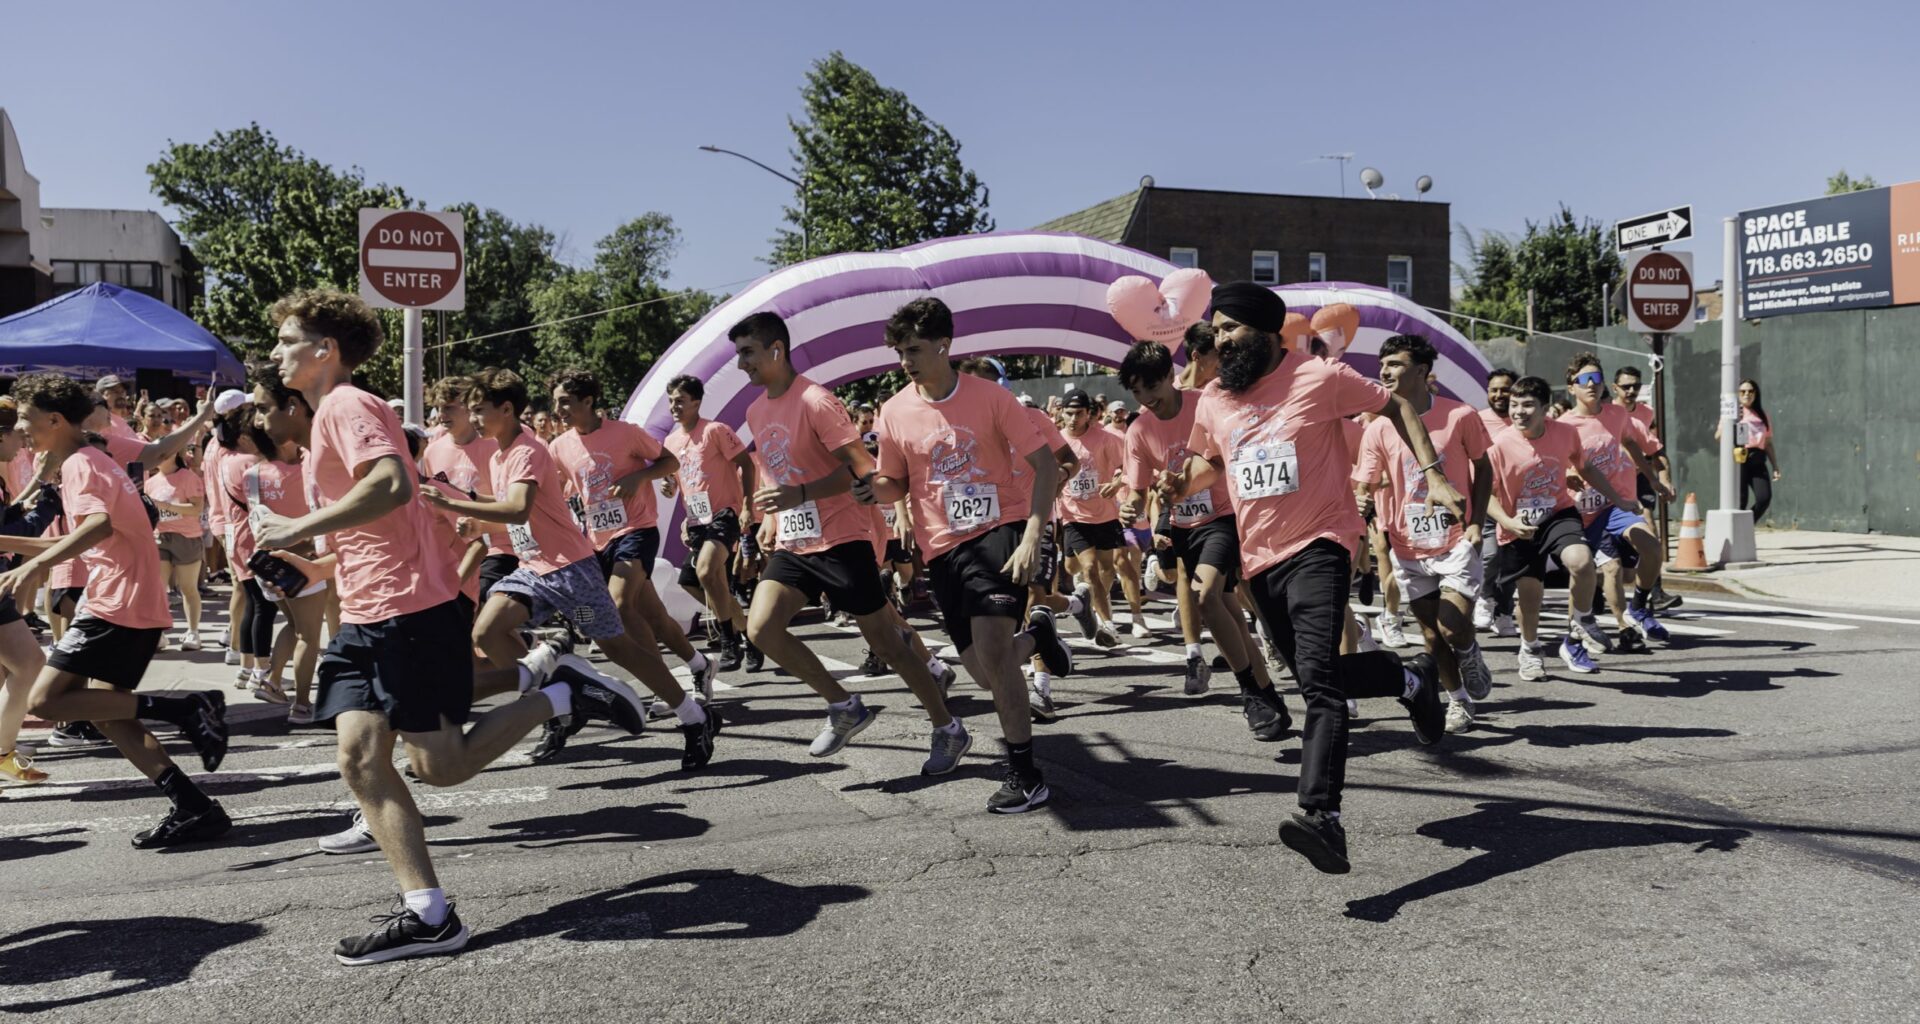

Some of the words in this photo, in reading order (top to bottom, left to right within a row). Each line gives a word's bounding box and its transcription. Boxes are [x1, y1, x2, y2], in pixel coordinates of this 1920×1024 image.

[1627, 227, 1648, 241] ONE
[1656, 219, 1680, 235] WAY
[1745, 210, 1807, 236] SPACE
[379, 228, 404, 245] DO
[410, 230, 444, 247] NOT
[1746, 221, 1850, 254] AVAILABLE
[1746, 243, 1873, 276] 718.663.2650
[383, 271, 442, 289] ENTER
[1639, 267, 1655, 280] DO
[1659, 267, 1681, 280] NOT
[1809, 284, 1831, 295] Greg
[1643, 303, 1680, 315] ENTER
[1748, 301, 1764, 311] and
[1763, 299, 1797, 310] Michelle
[1072, 478, 1095, 491] 2561
[1242, 461, 1291, 491] 3474
[952, 497, 992, 519] 2627
[593, 509, 622, 528] 2345
[783, 511, 815, 534] 2695
